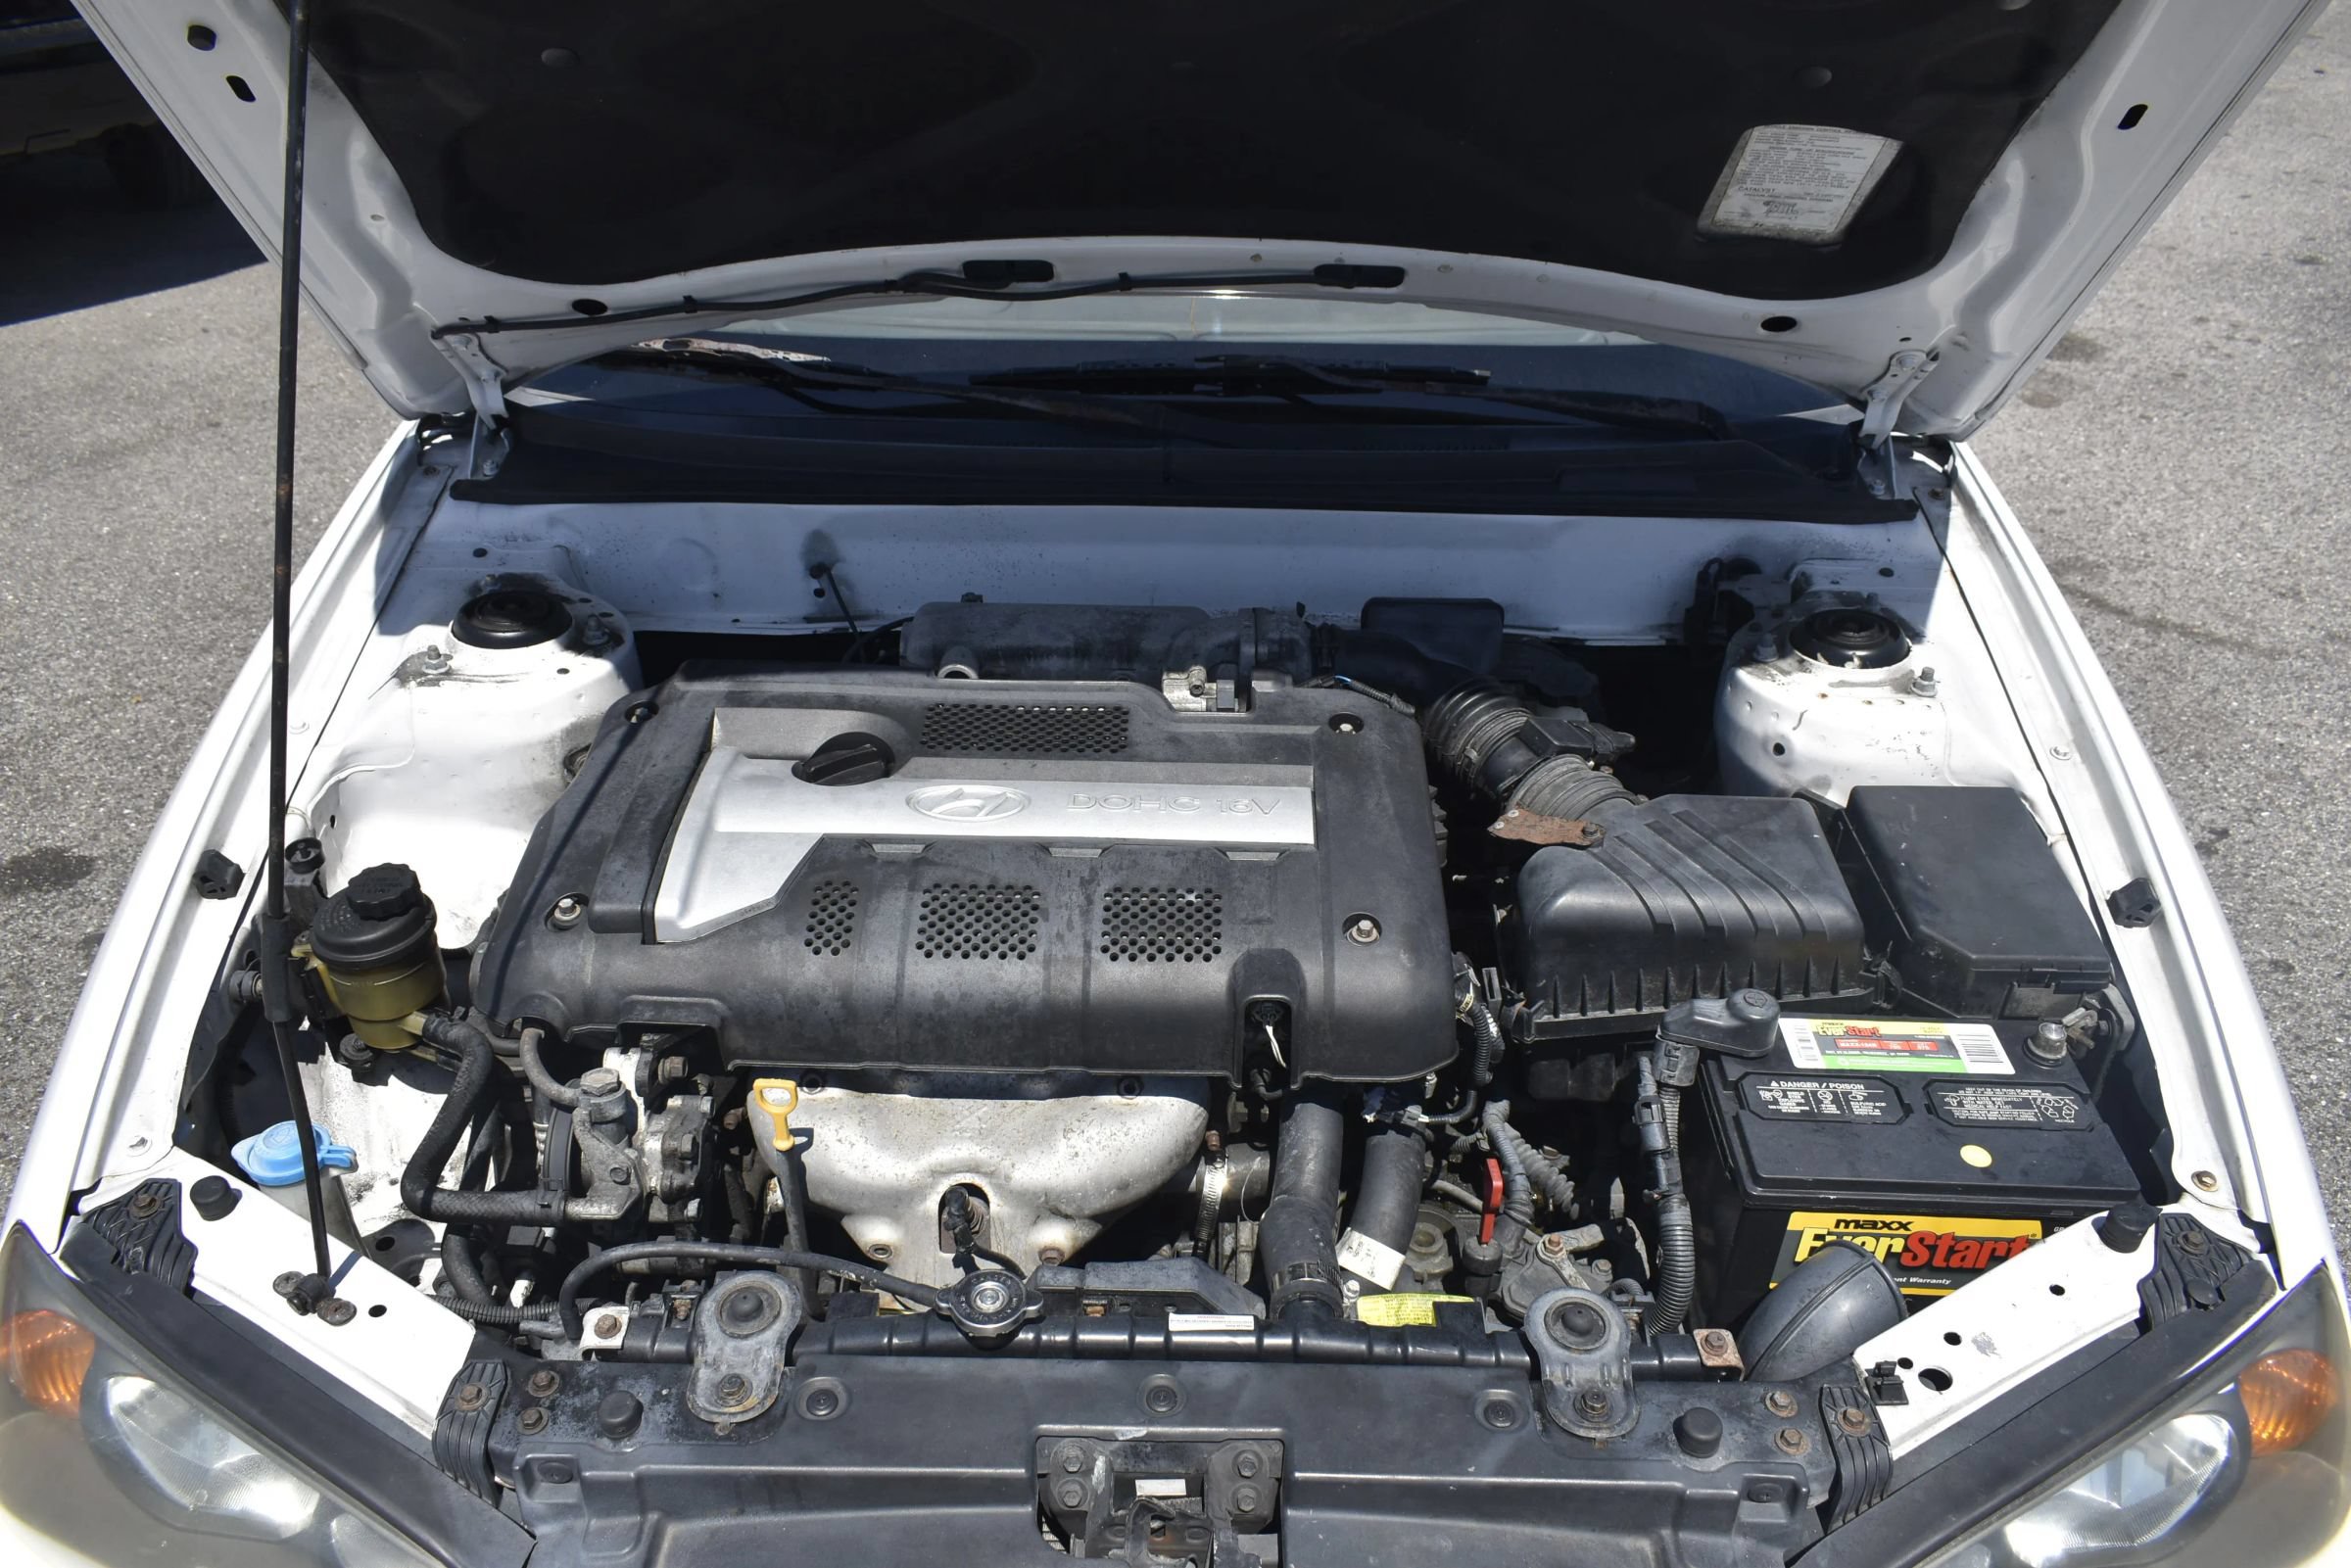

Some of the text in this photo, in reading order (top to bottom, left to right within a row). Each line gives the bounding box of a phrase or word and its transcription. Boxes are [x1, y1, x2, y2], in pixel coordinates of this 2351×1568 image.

[1066, 791, 1281, 815] DOHC 16V
[1816, 1024, 1882, 1038] EverStart
[1834, 1218, 1914, 1232] maxx
[1909, 1276, 1952, 1286] Warranty
